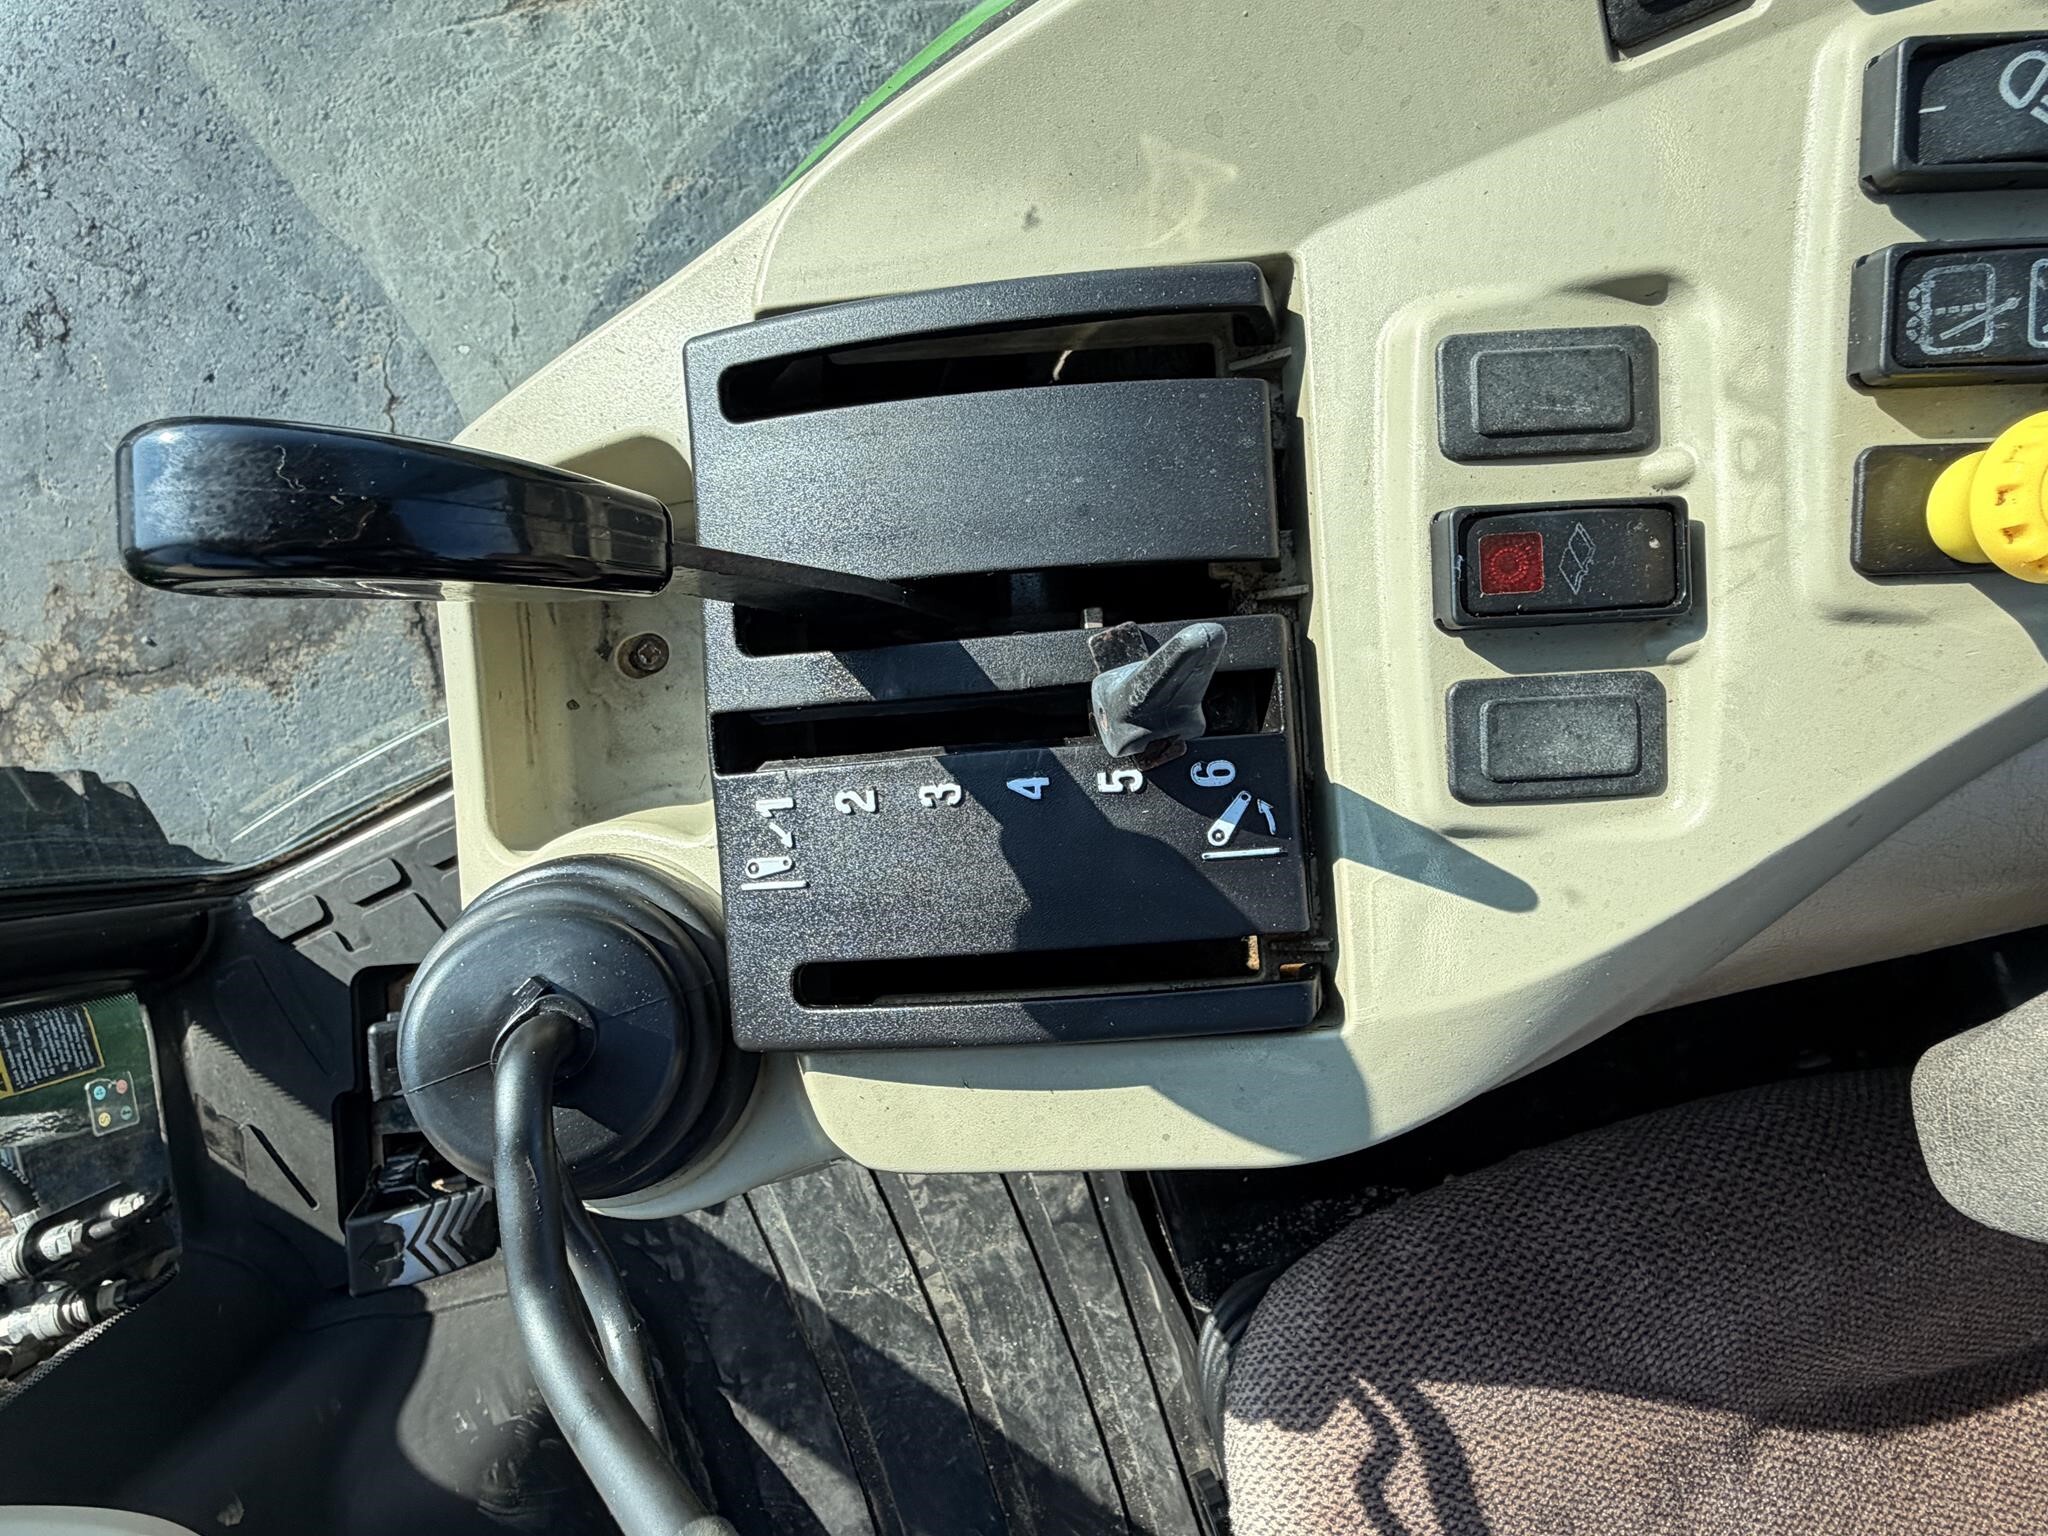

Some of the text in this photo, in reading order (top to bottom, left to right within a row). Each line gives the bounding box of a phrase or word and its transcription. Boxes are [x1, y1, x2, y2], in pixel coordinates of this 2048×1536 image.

[756, 760, 1237, 819] 1 2 3 4 5 6
